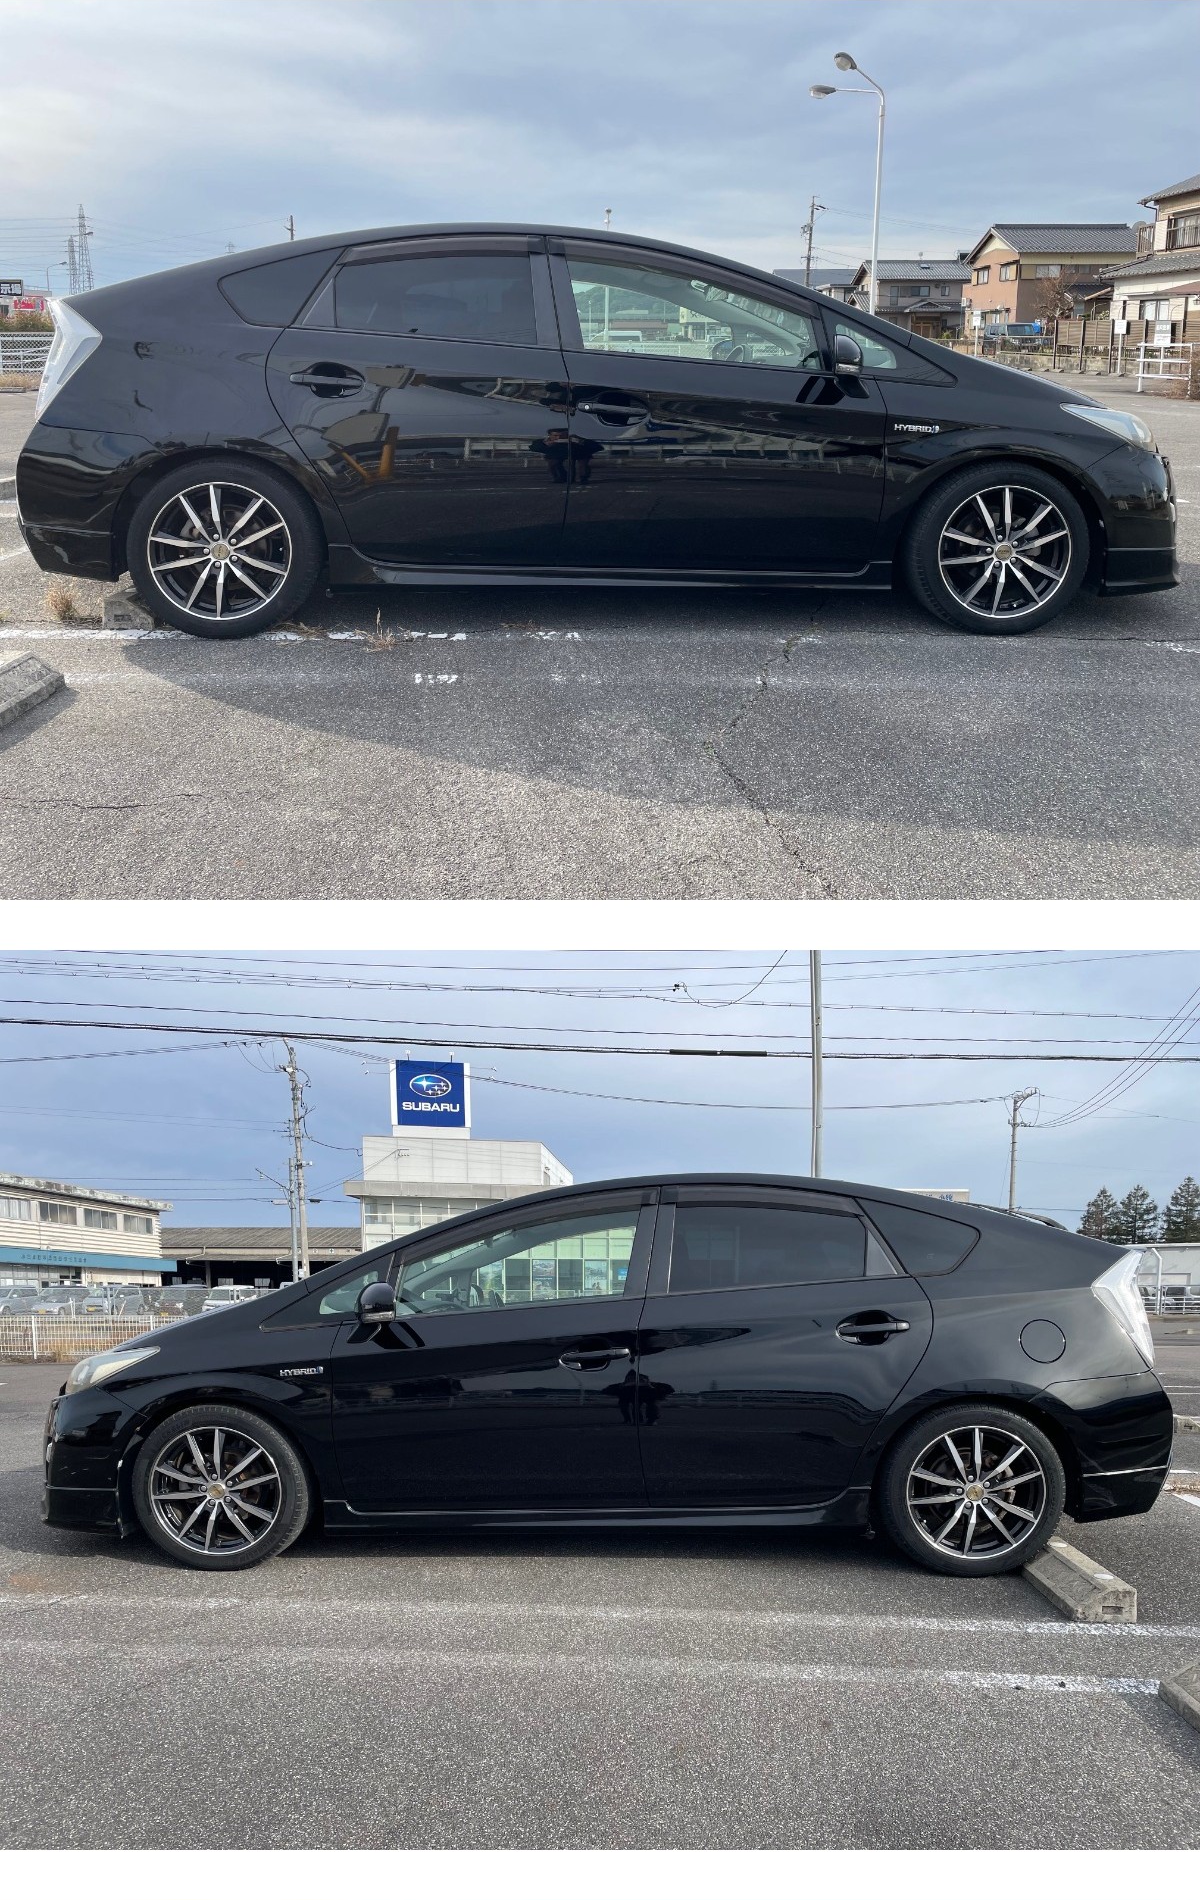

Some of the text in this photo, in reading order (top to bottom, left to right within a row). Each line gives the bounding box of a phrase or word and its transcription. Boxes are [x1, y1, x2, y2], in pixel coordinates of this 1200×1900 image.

[894, 423, 932, 433] HYBRID
[402, 1101, 460, 1113] SUBARU
[279, 1367, 317, 1377] HYBRID
